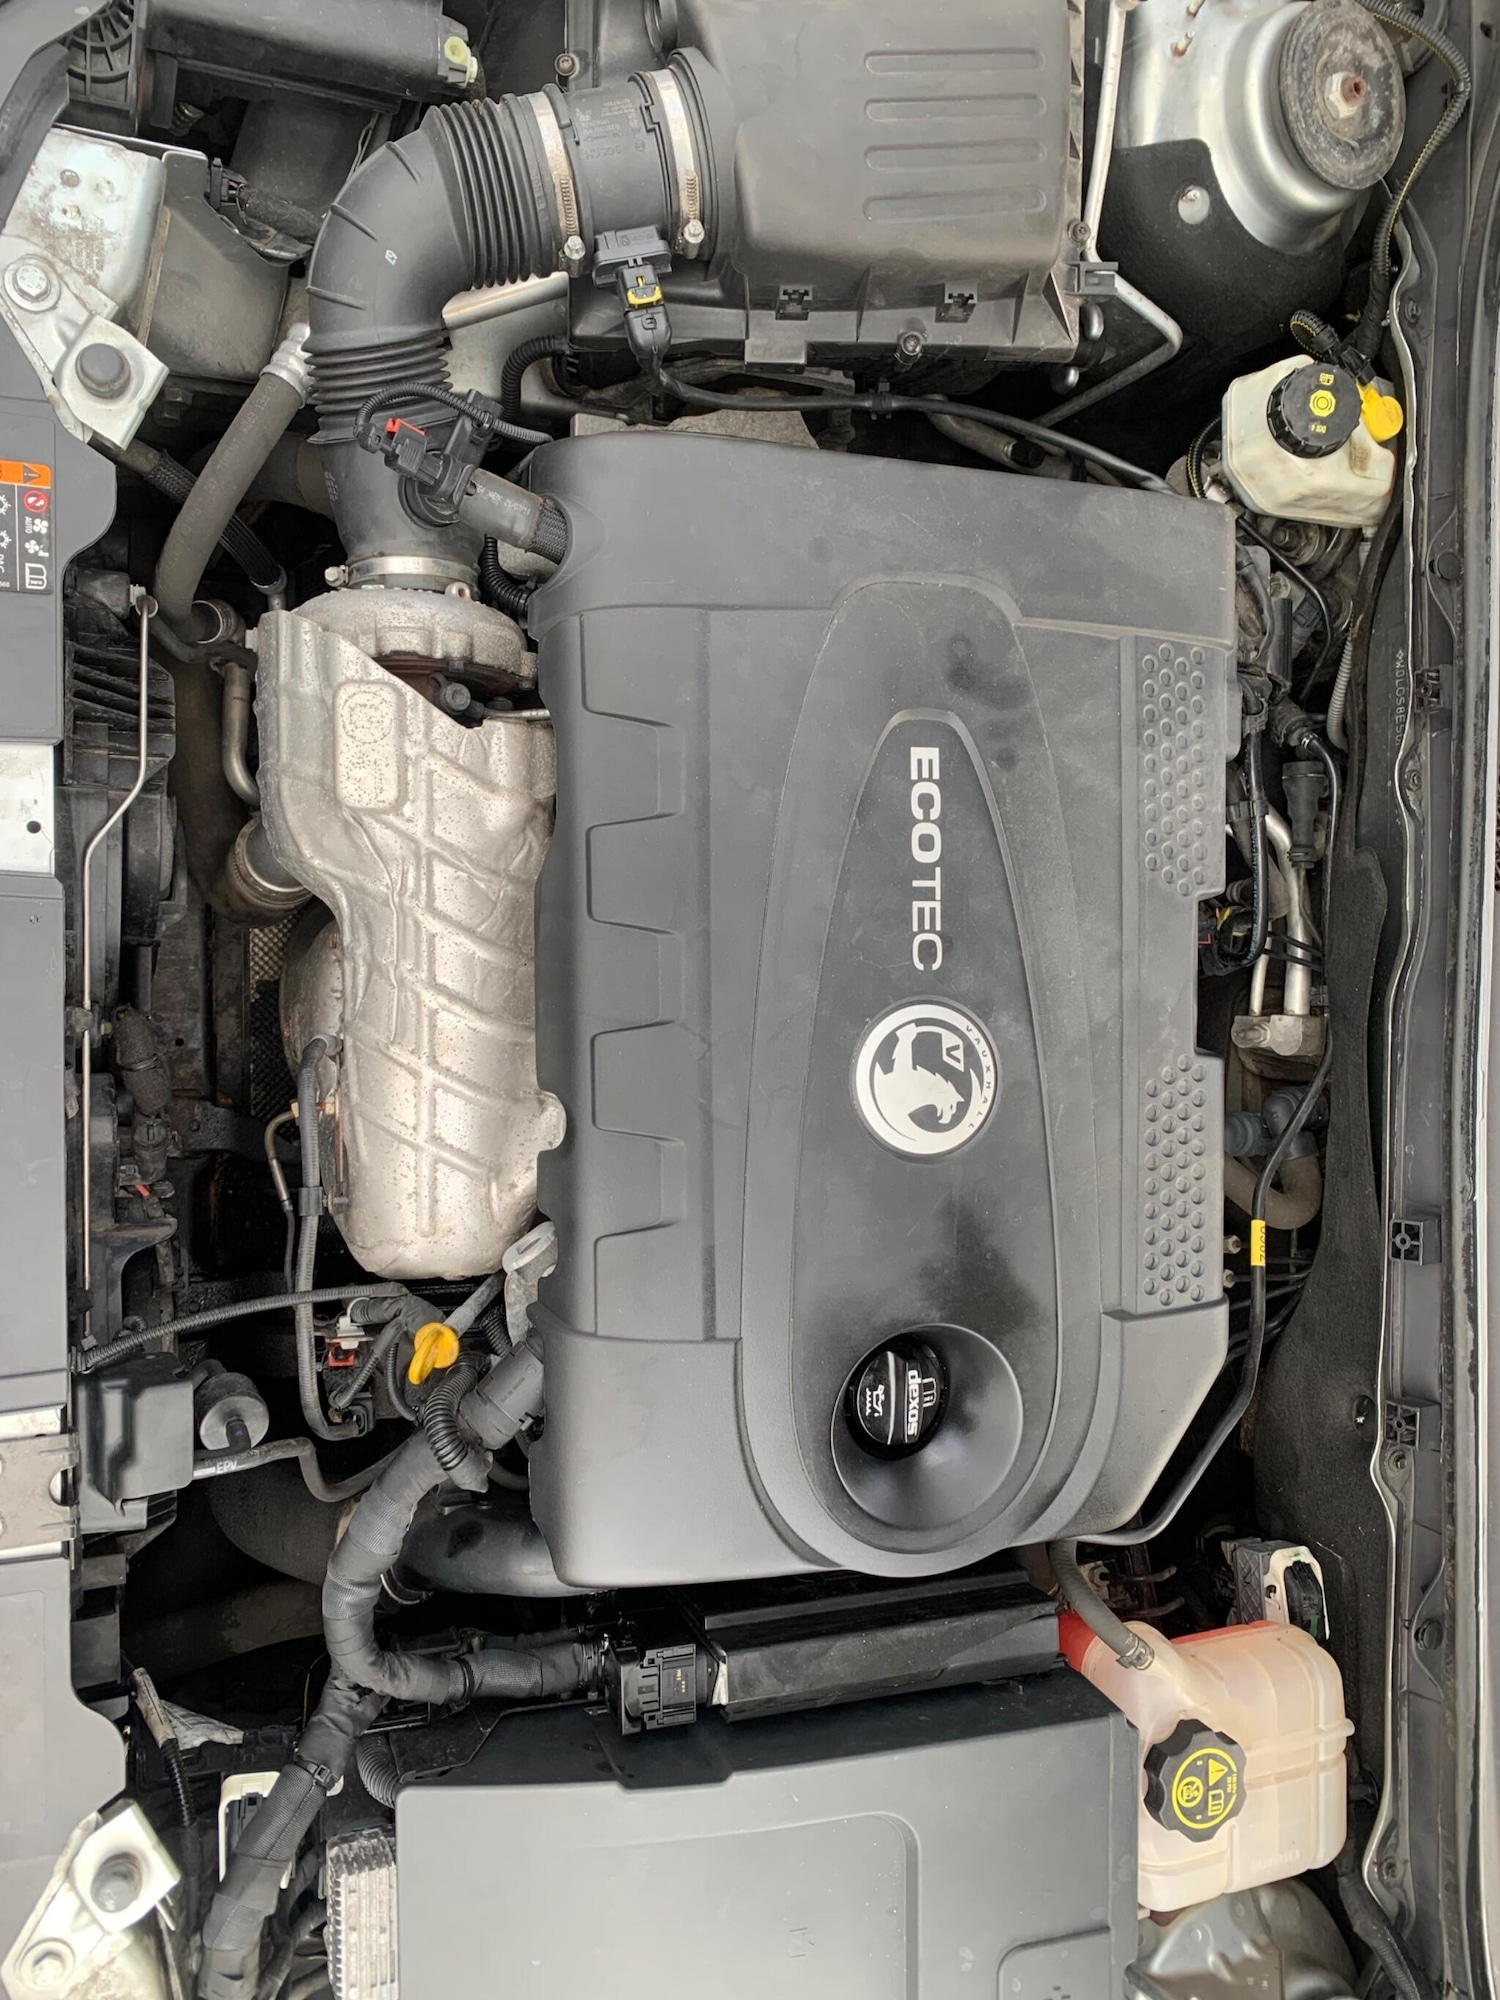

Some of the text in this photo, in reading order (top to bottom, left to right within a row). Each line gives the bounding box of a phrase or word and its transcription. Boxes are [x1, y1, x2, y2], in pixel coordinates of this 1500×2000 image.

[24, 516, 33, 534] AUTO
[910, 746, 942, 971] ECOTEC
[946, 1044, 961, 1064] V
[965, 1025, 992, 1130] VAUXHALL
[907, 1370, 922, 1436] dexos
